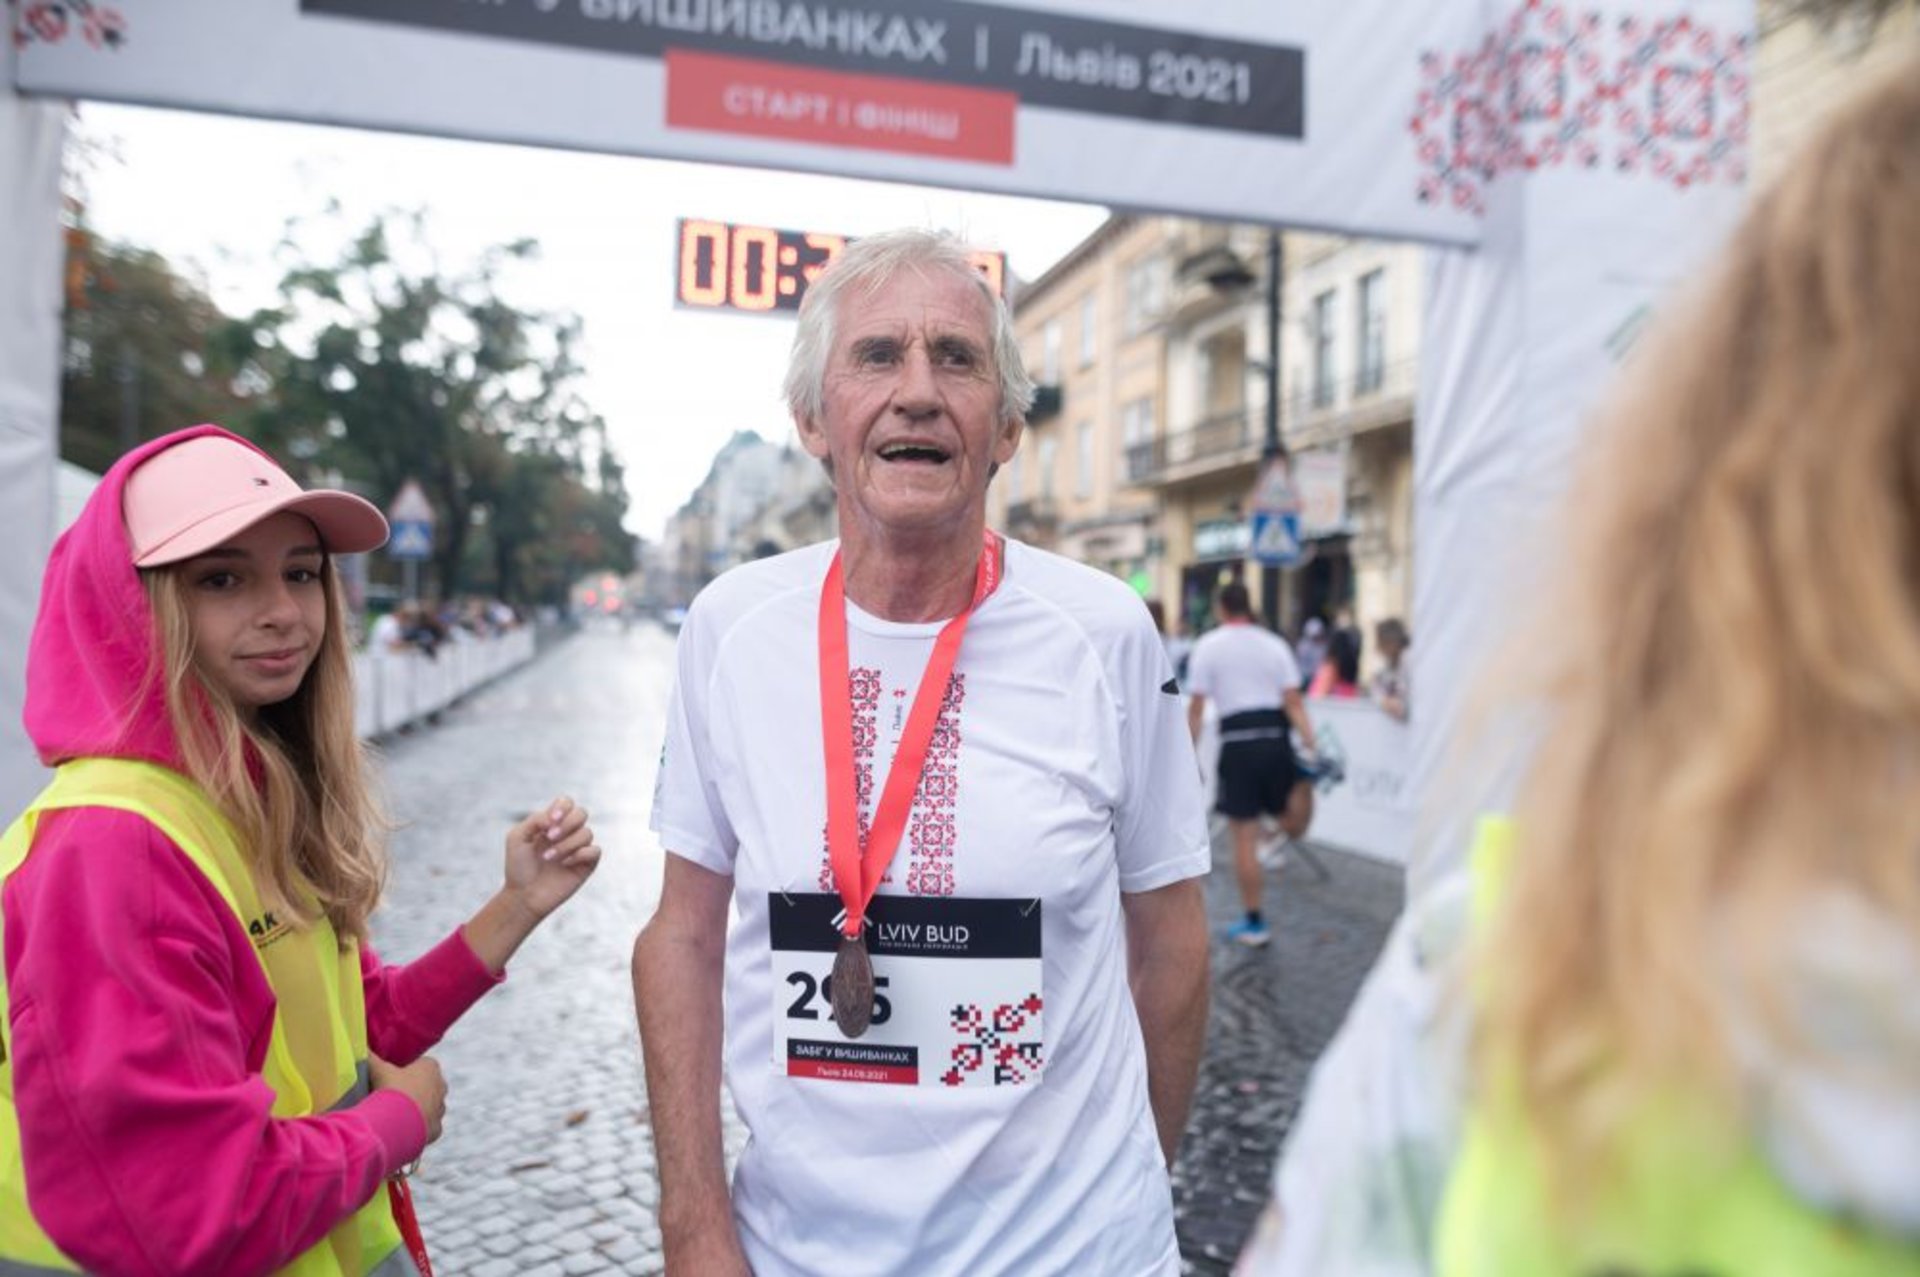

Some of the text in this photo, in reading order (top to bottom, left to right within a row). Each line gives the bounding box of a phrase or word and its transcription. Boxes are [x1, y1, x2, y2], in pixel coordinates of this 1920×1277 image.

[1015, 31, 1142, 91] Львів
[1148, 50, 1251, 103] 2021
[723, 83, 829, 125] СТАРТ
[878, 923, 969, 943] LVIV BUD
[785, 970, 892, 1026] 25
[834, 1046, 909, 1062] ВИШИВАНКАХ
